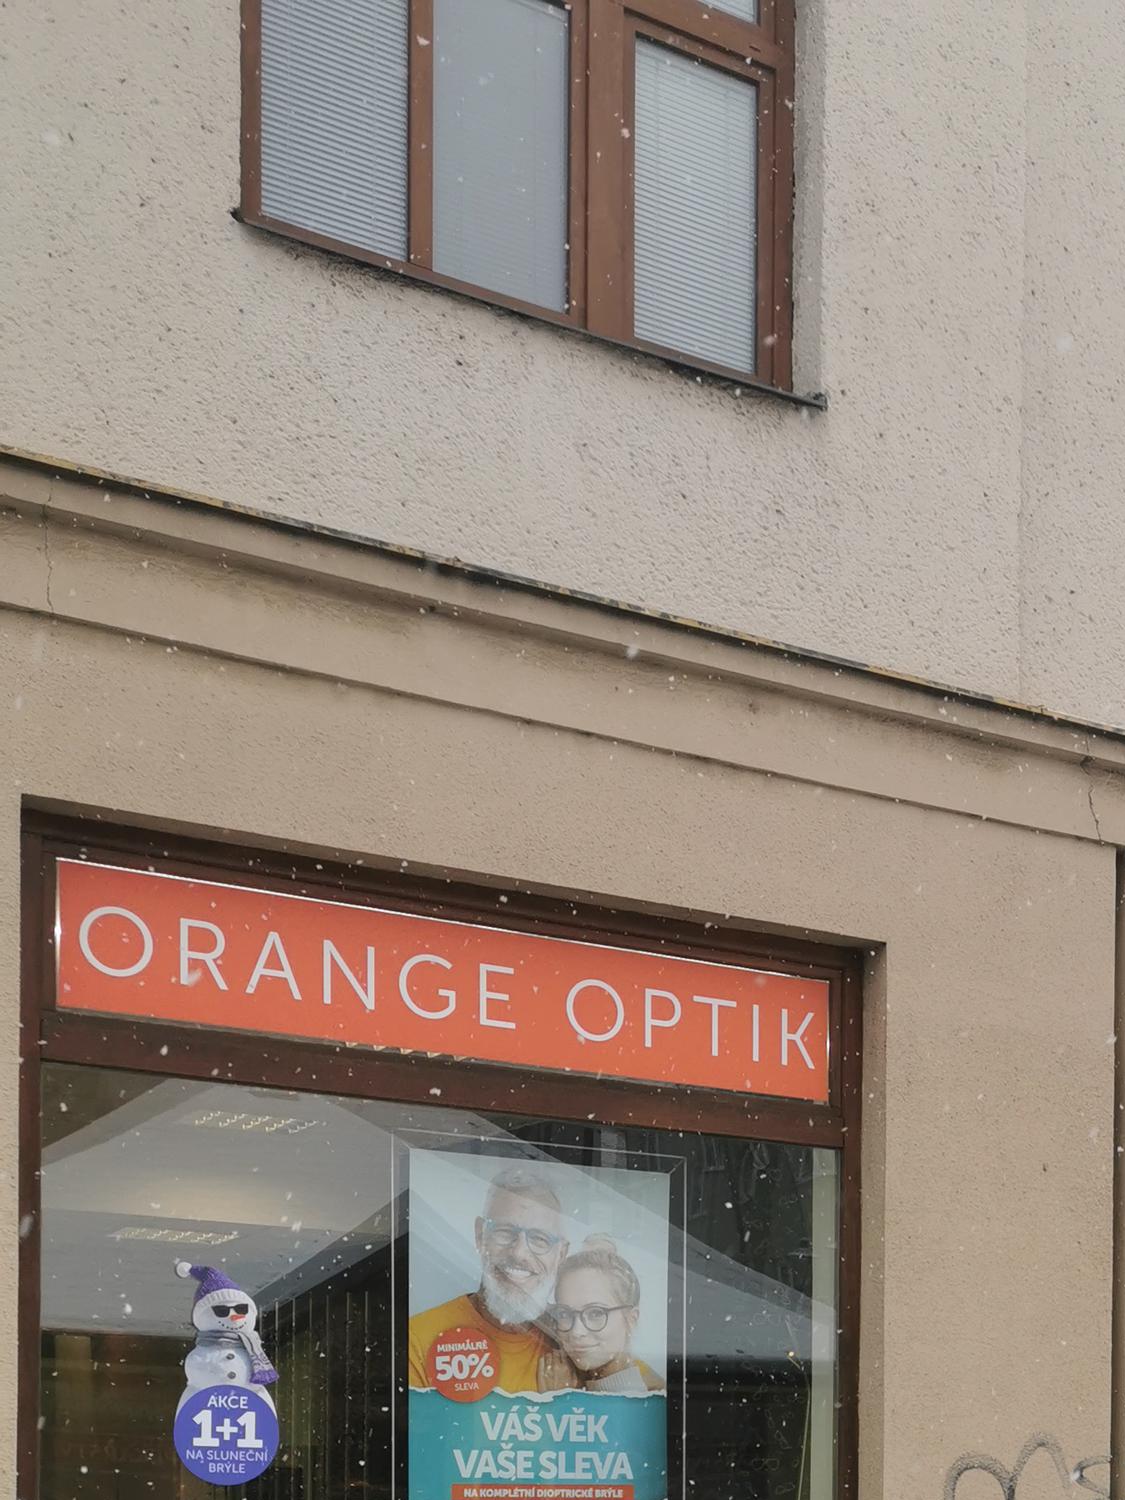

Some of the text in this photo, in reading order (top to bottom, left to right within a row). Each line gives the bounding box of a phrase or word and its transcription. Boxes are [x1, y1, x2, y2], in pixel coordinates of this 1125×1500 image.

[79, 906, 816, 1071] ORANGE OPTIK
[435, 1352, 495, 1382] 50%
[454, 1382, 480, 1392] SLEVA
[207, 1394, 249, 1409] AKCE
[192, 1409, 264, 1449] 1+1
[479, 1405, 609, 1444] VÁŠ VĚK
[186, 1449, 268, 1462] NA SLUNEČNÍ
[453, 1443, 635, 1481] VAŠE SLEVA
[208, 1461, 246, 1474] BRÝLE
[463, 1488, 477, 1498] NA
[536, 1486, 594, 1500] DIOPTRICKÉ
[594, 1488, 624, 1499] BRÝLE
